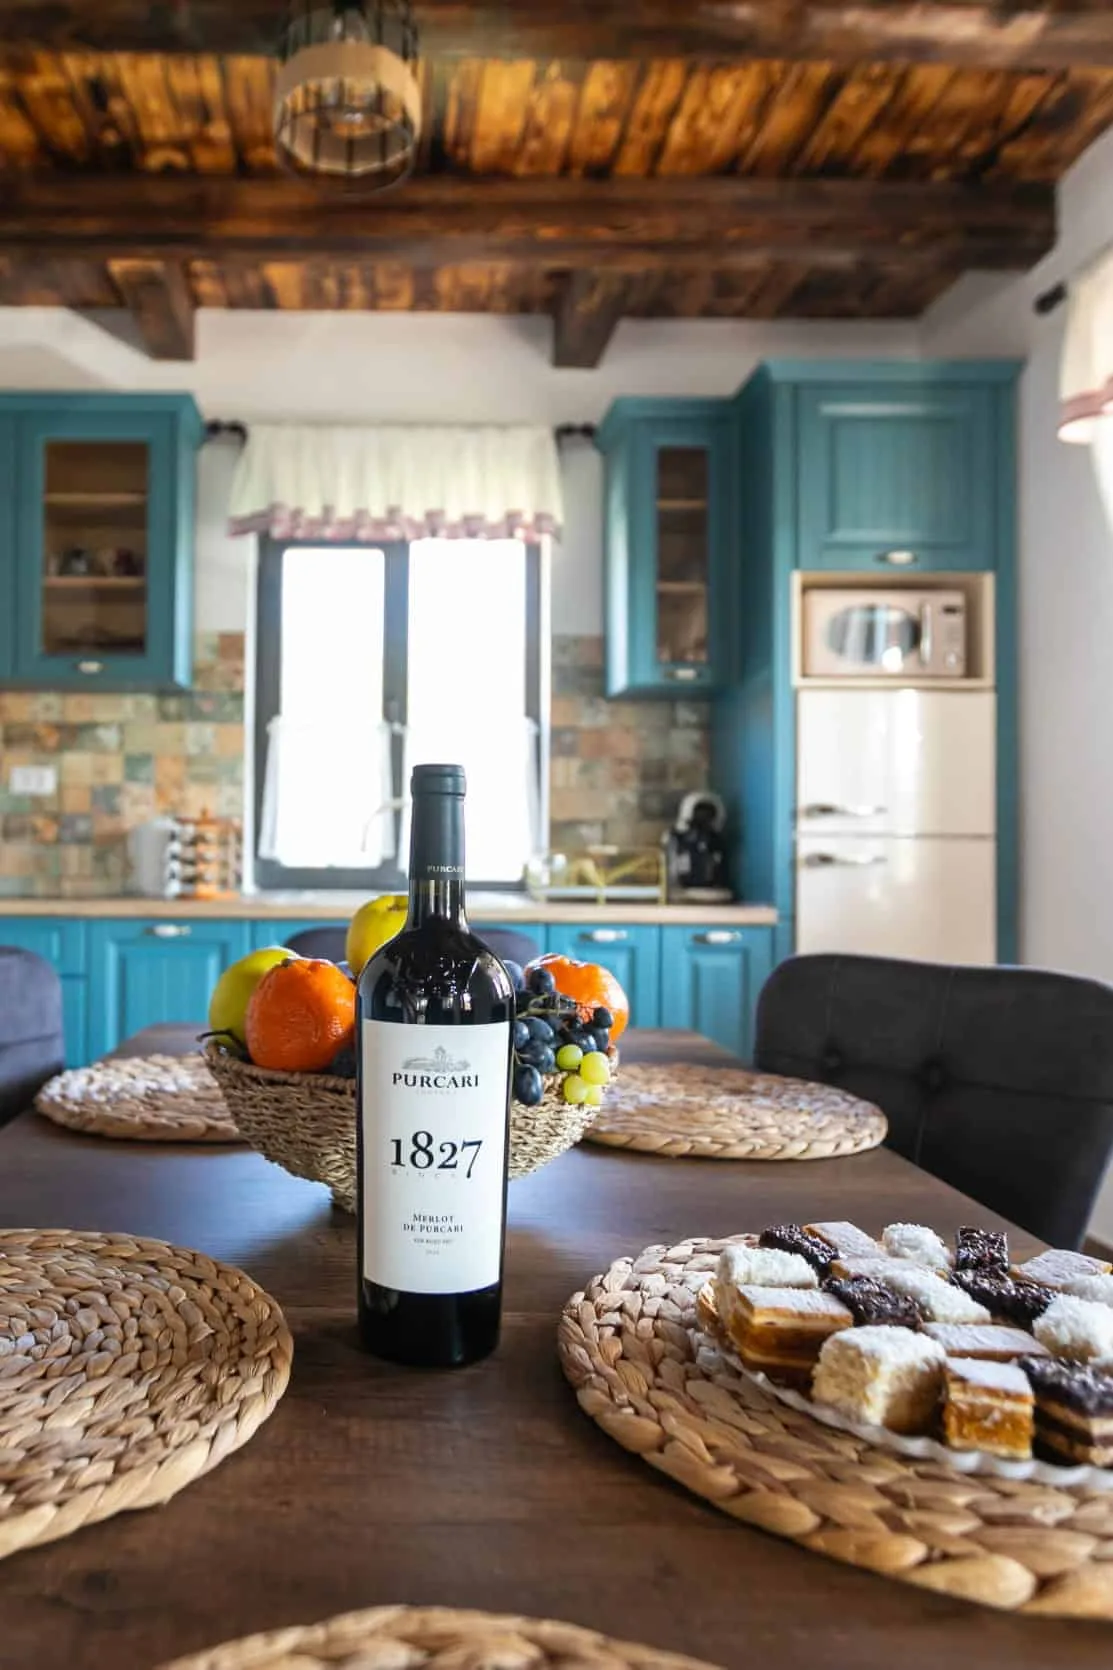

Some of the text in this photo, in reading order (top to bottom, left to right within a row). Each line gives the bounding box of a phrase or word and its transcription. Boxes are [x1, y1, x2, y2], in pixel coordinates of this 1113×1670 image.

[392, 1072, 479, 1088] PURCARI
[390, 1130, 483, 1178] 1827
[403, 1223, 463, 1233] DE PURCARI
